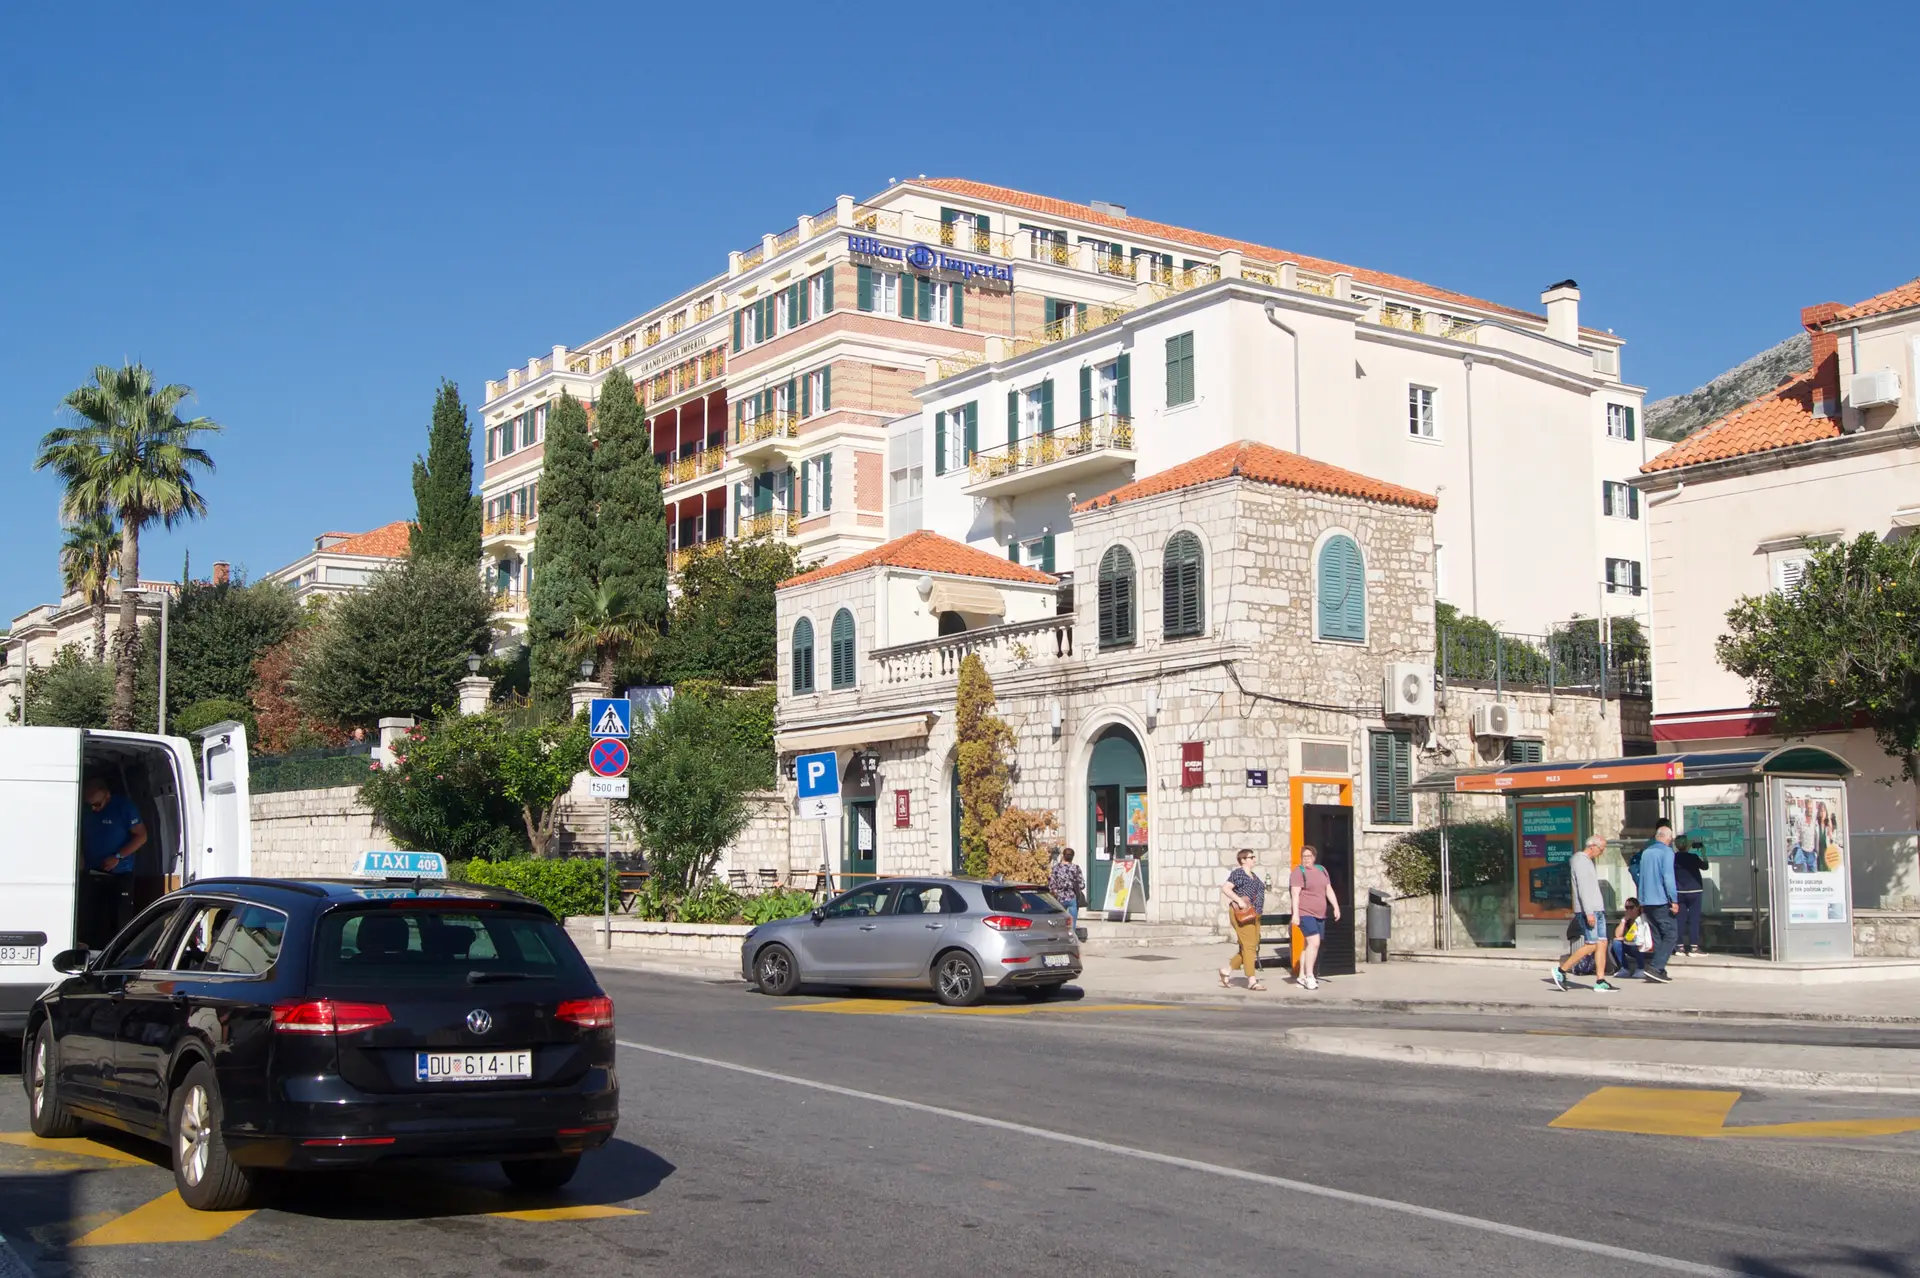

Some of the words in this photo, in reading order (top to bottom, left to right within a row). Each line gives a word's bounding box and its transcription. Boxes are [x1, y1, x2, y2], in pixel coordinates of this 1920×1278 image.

[847, 235, 903, 260] Hilton
[940, 253, 1013, 281] Imperial
[641, 357, 661, 374] GRAND
[661, 349, 679, 363] HOTEL
[681, 335, 707, 355] IMPERIAL
[808, 761, 826, 789] P
[1667, 767, 1673, 776] 4
[596, 783, 612, 792] 500
[370, 853, 409, 869] TAXI
[417, 859, 438, 871] 409
[430, 1056, 451, 1075] DU
[465, 1055, 527, 1074] 614-IF
